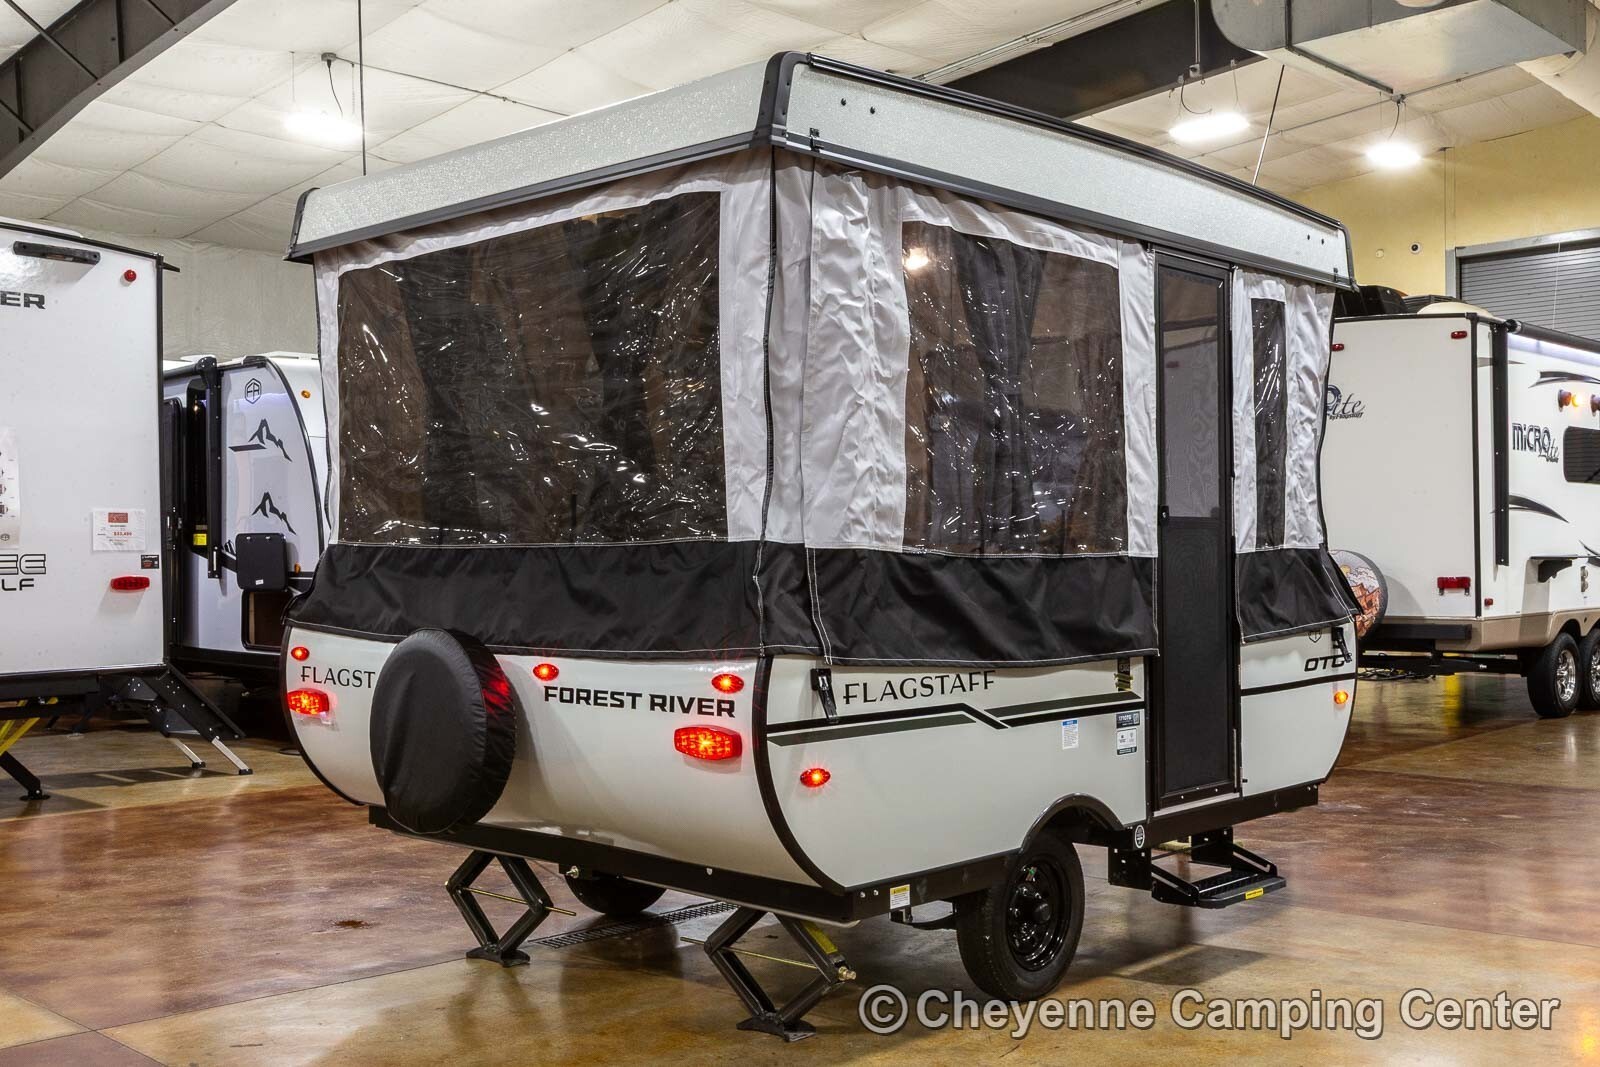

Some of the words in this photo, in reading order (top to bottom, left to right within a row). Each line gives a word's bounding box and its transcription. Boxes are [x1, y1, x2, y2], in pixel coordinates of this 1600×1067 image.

[300, 665, 376, 689] FLAGST
[842, 669, 996, 705] FLAGSTAFF
[543, 685, 643, 710] FOREST
[648, 693, 736, 718] RIVER
